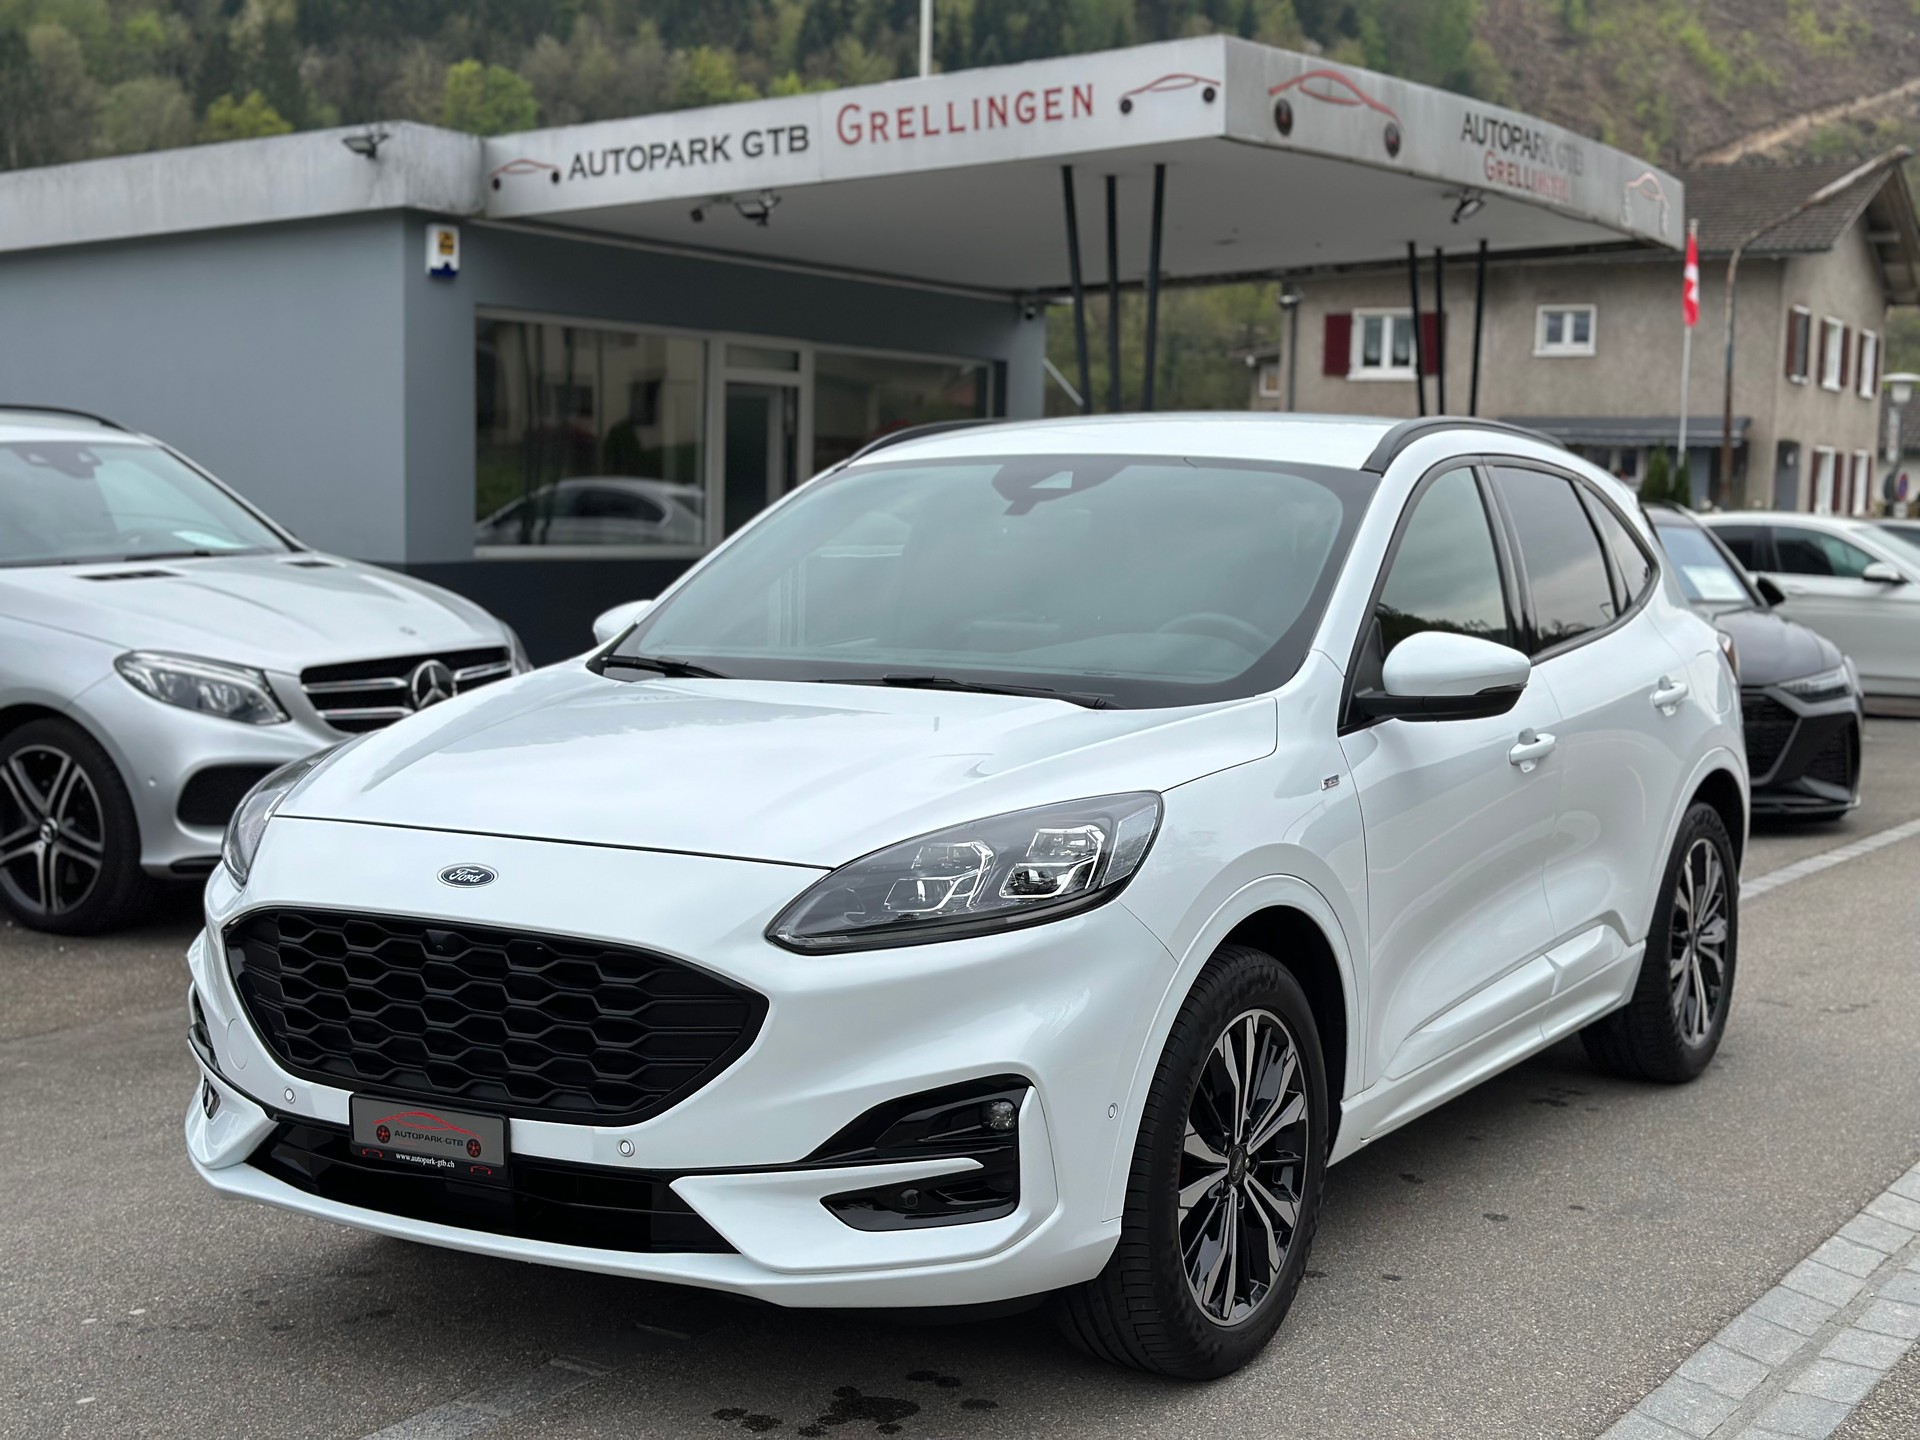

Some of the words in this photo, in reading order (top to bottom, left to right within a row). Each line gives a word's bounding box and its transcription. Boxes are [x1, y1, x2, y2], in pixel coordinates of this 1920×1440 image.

[568, 133, 732, 180] AUTOPARK
[742, 125, 810, 158] GTB
[836, 84, 1094, 146] GRELLINGEN
[1461, 111, 1554, 167] AUTOPARK
[449, 868, 485, 882] Ford
[395, 1152, 455, 1168] www.autopark-gtb.ch
